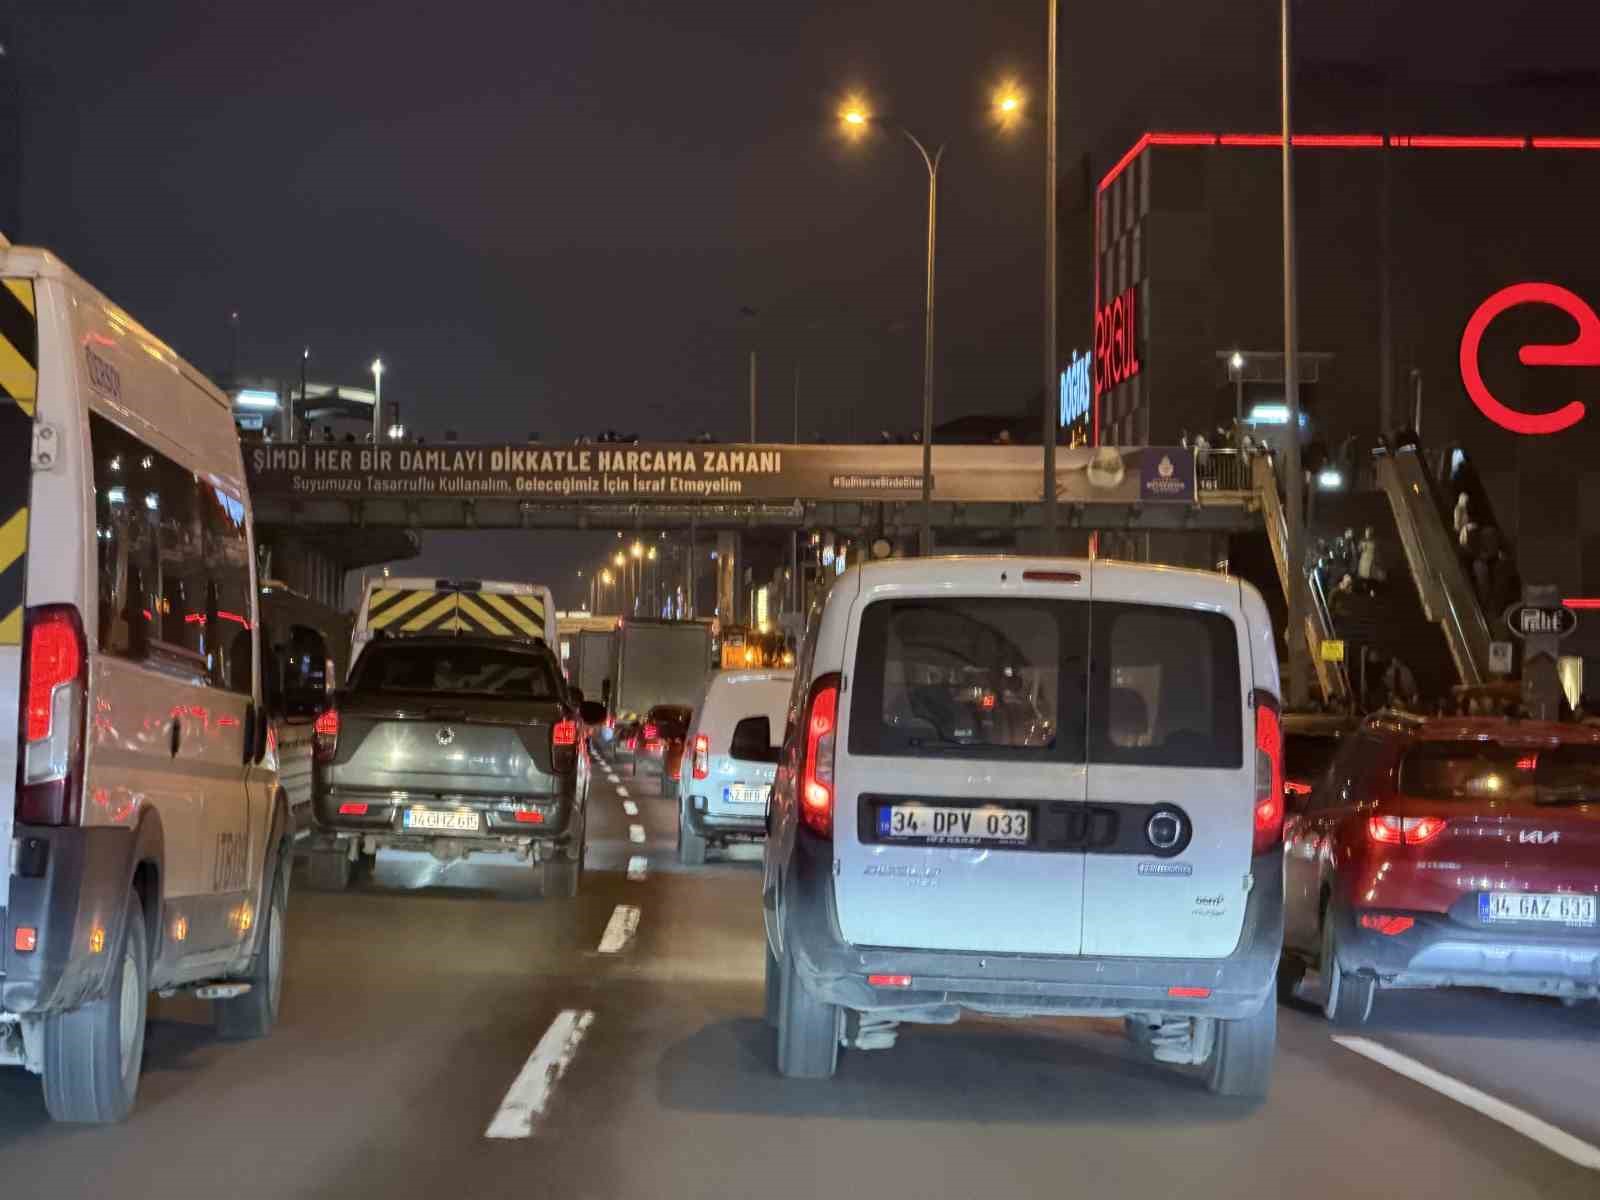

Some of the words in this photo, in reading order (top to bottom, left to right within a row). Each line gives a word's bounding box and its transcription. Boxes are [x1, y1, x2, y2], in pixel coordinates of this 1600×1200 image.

[254, 446, 307, 473] ŞİMDİ
[315, 449, 351, 471] HER
[360, 446, 392, 472] BİR
[401, 450, 483, 471] DAMLAYI
[491, 446, 591, 472] DİKKATLE
[599, 450, 696, 472] HARCAMA
[703, 451, 781, 473] ZAMANI
[293, 476, 361, 494] Suyumuzu
[604, 473, 629, 494] İçin
[633, 473, 665, 492] İsraf
[671, 476, 741, 495] Etmeyelim
[893, 811, 918, 833] 34
[933, 811, 972, 835] DPV
[986, 813, 1027, 836] 033
